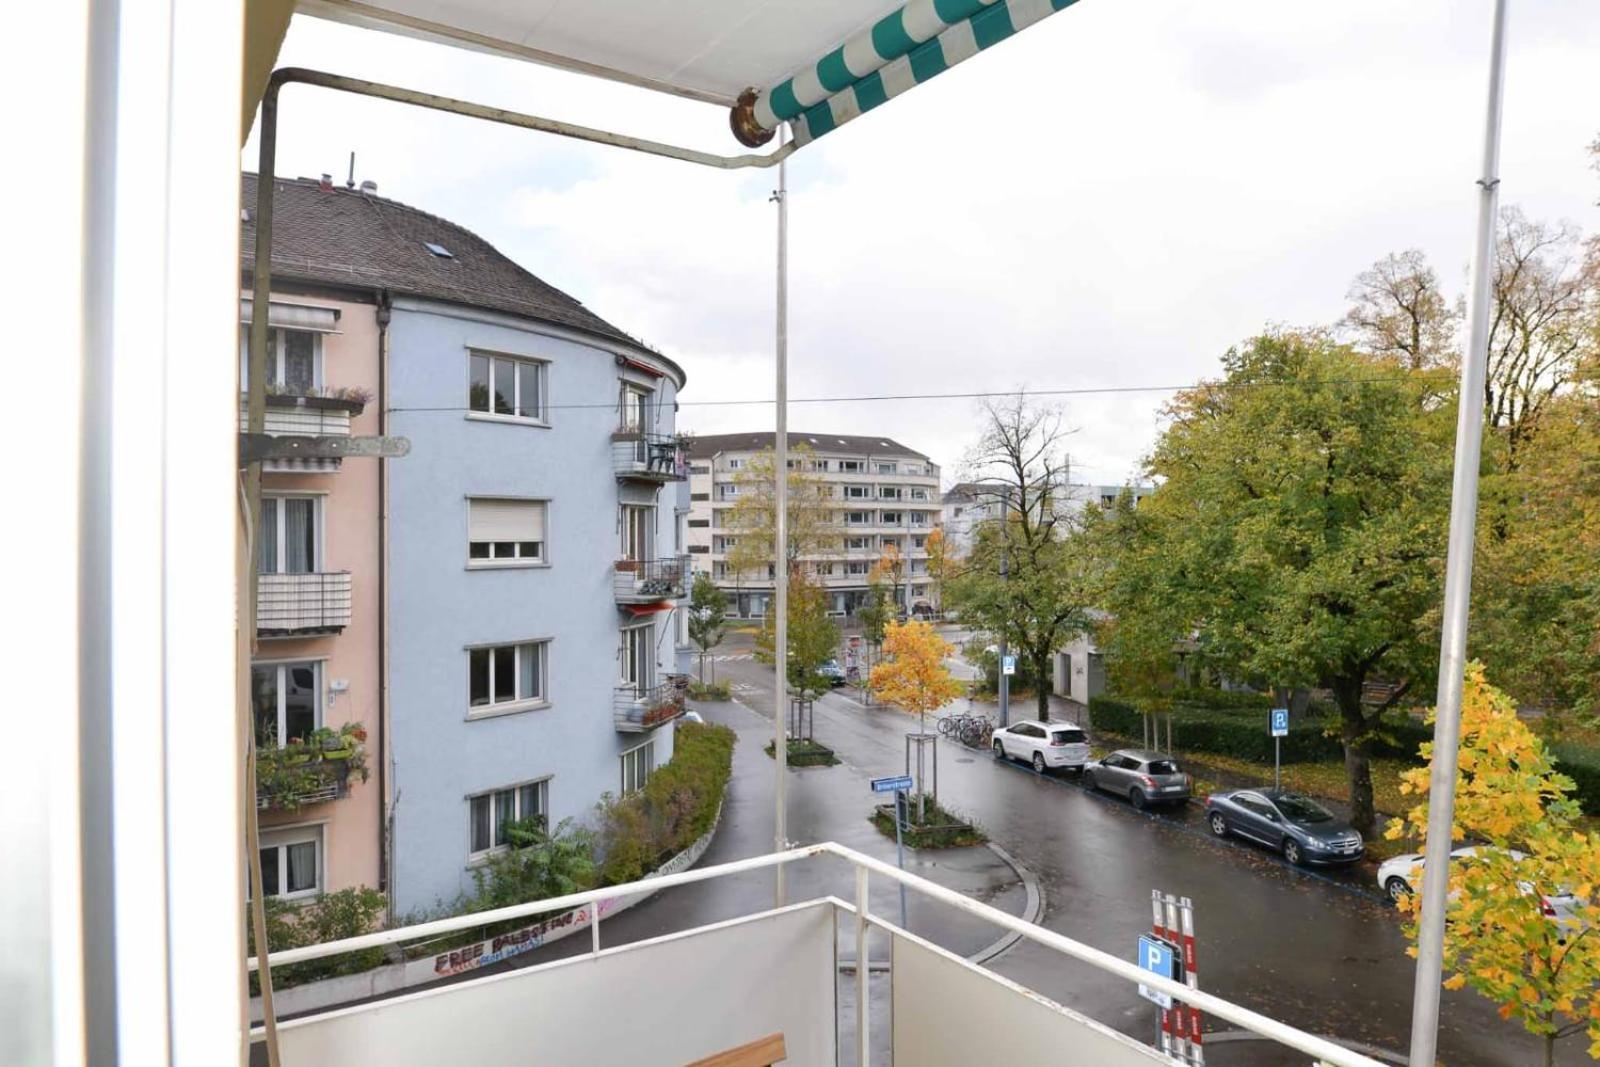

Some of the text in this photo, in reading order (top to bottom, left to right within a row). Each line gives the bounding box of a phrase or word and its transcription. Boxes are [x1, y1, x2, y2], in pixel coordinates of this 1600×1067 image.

[1276, 713, 1284, 727] P
[434, 943, 484, 972] FREE
[1148, 944, 1161, 970] P
